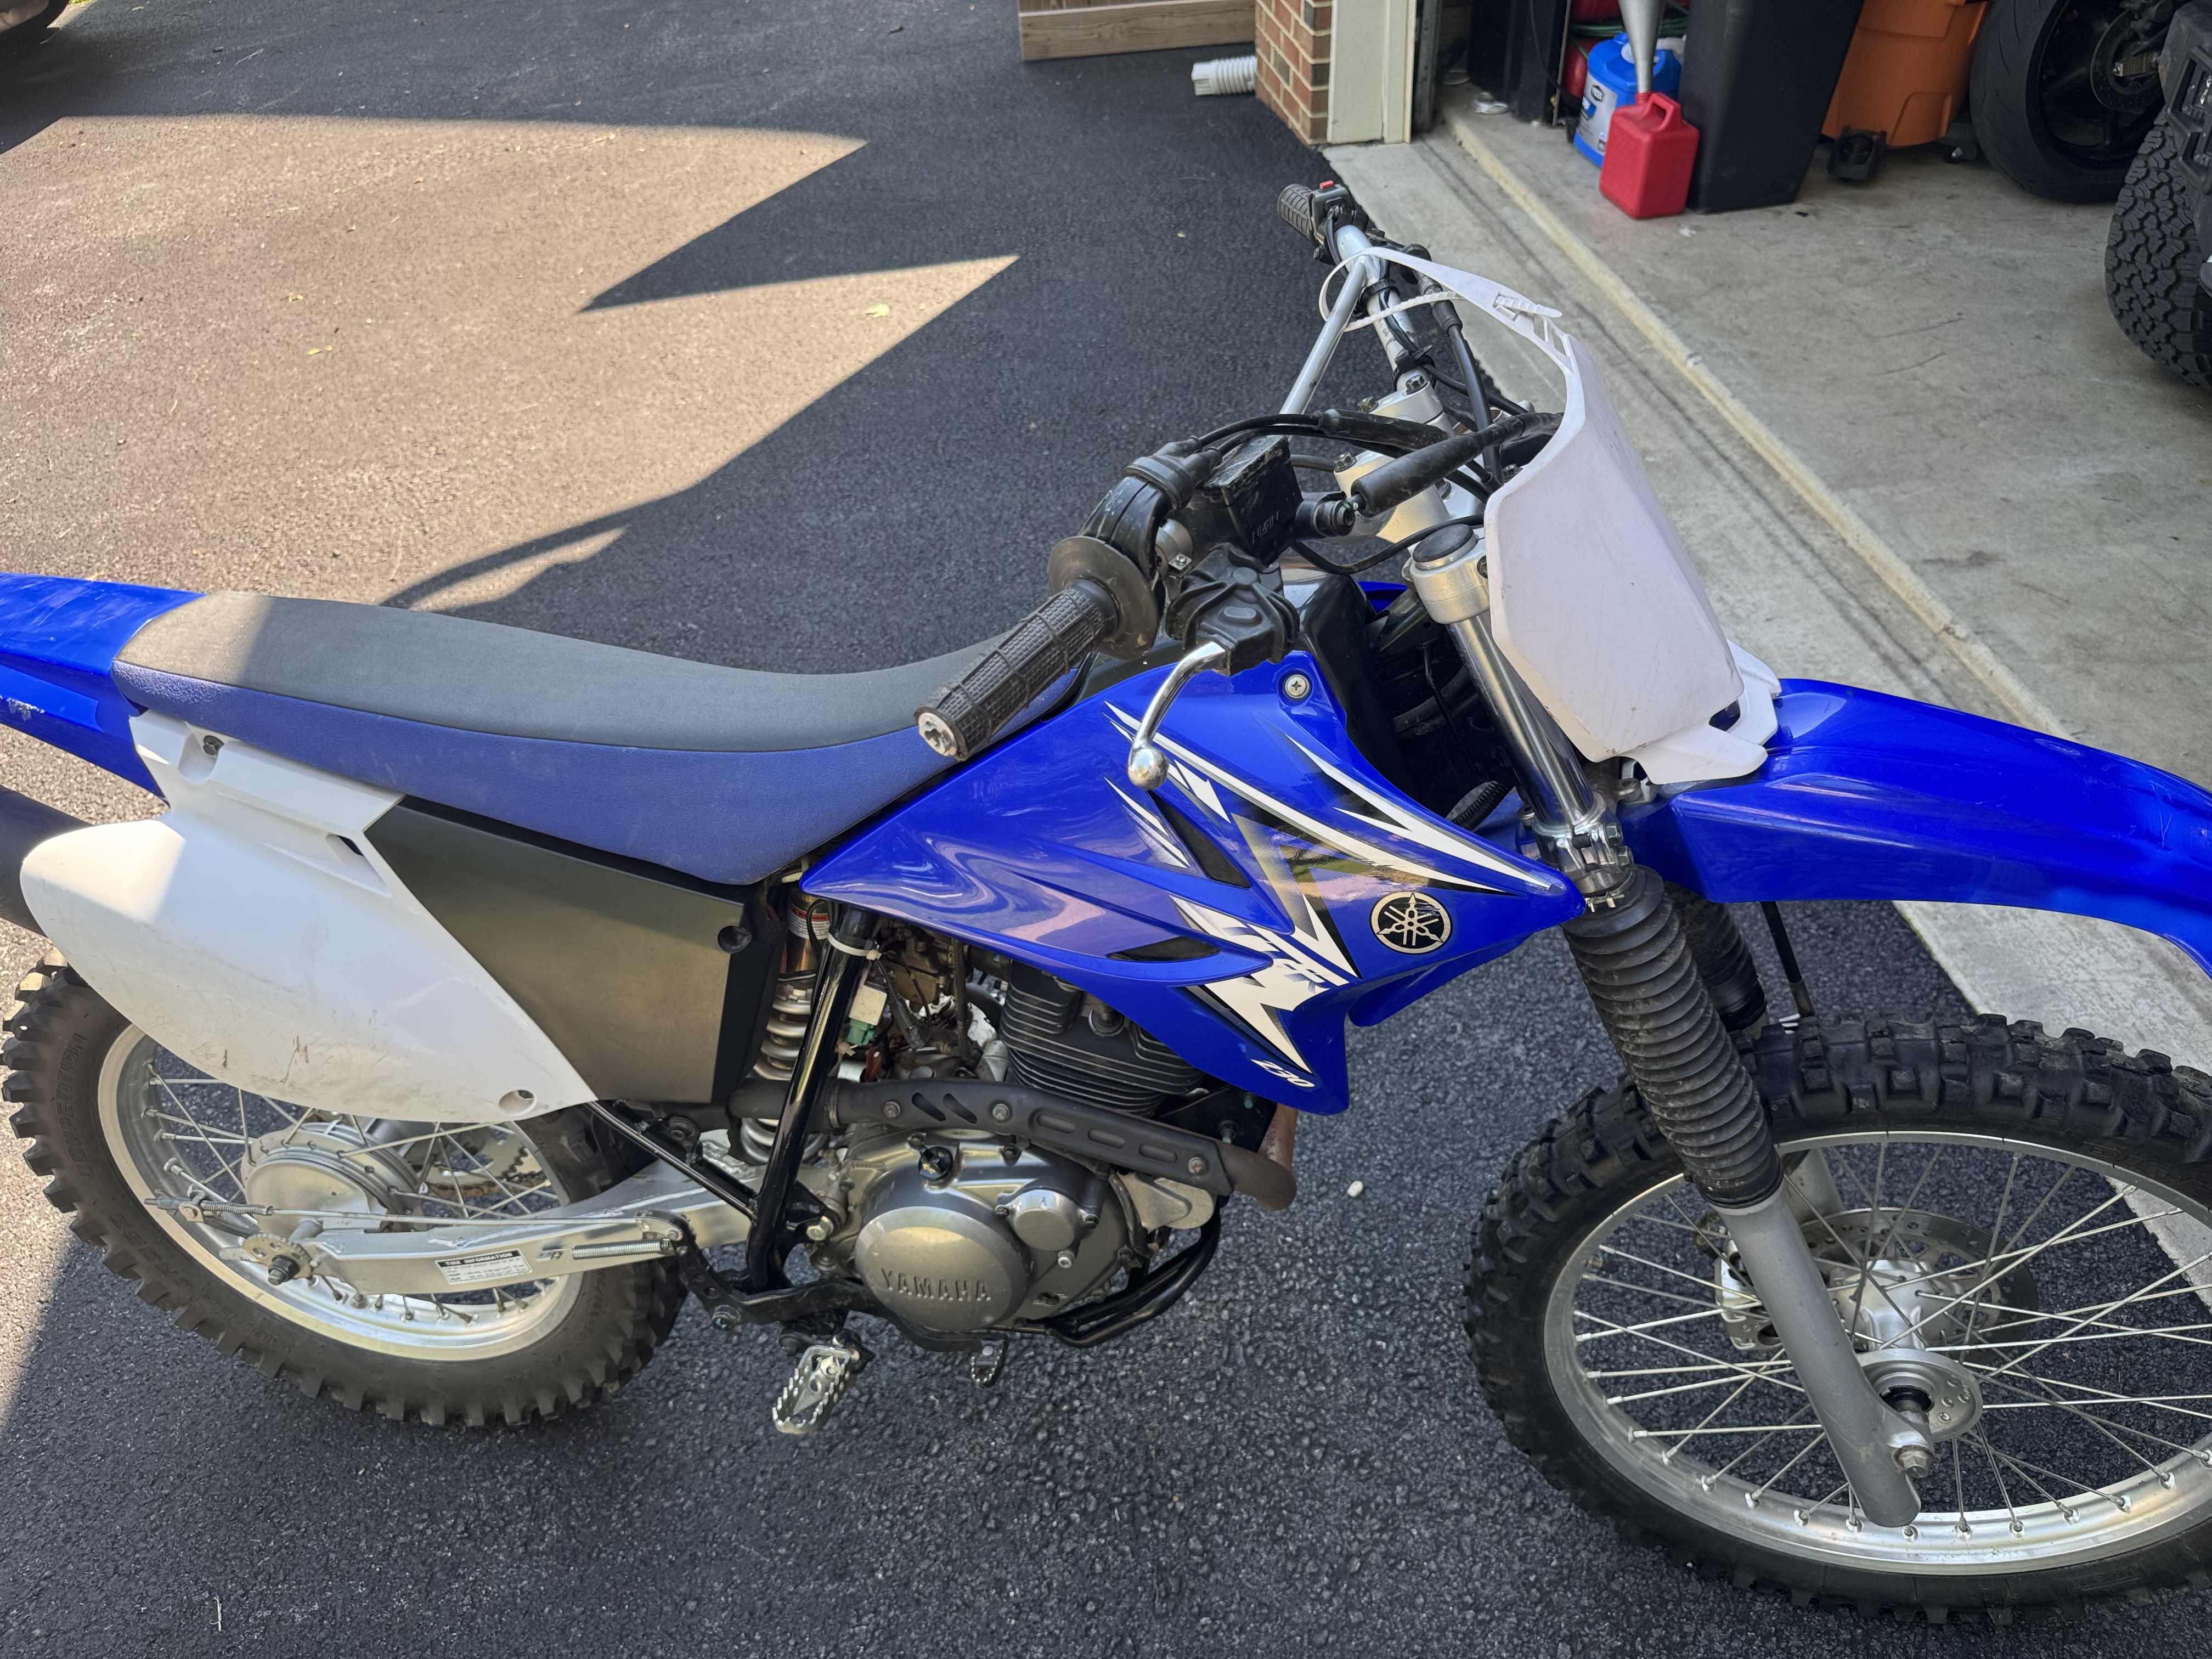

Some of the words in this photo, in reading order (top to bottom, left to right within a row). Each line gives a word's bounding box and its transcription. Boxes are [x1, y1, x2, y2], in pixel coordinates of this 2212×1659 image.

[799, 912, 827, 920] WANING
[1250, 1059, 1315, 1087] 230
[56, 1033, 94, 1177] COMPETITION
[110, 1214, 192, 1289] CROSS
[464, 1252, 513, 1263] INFORMATION
[881, 1268, 992, 1302] YAMAHA
